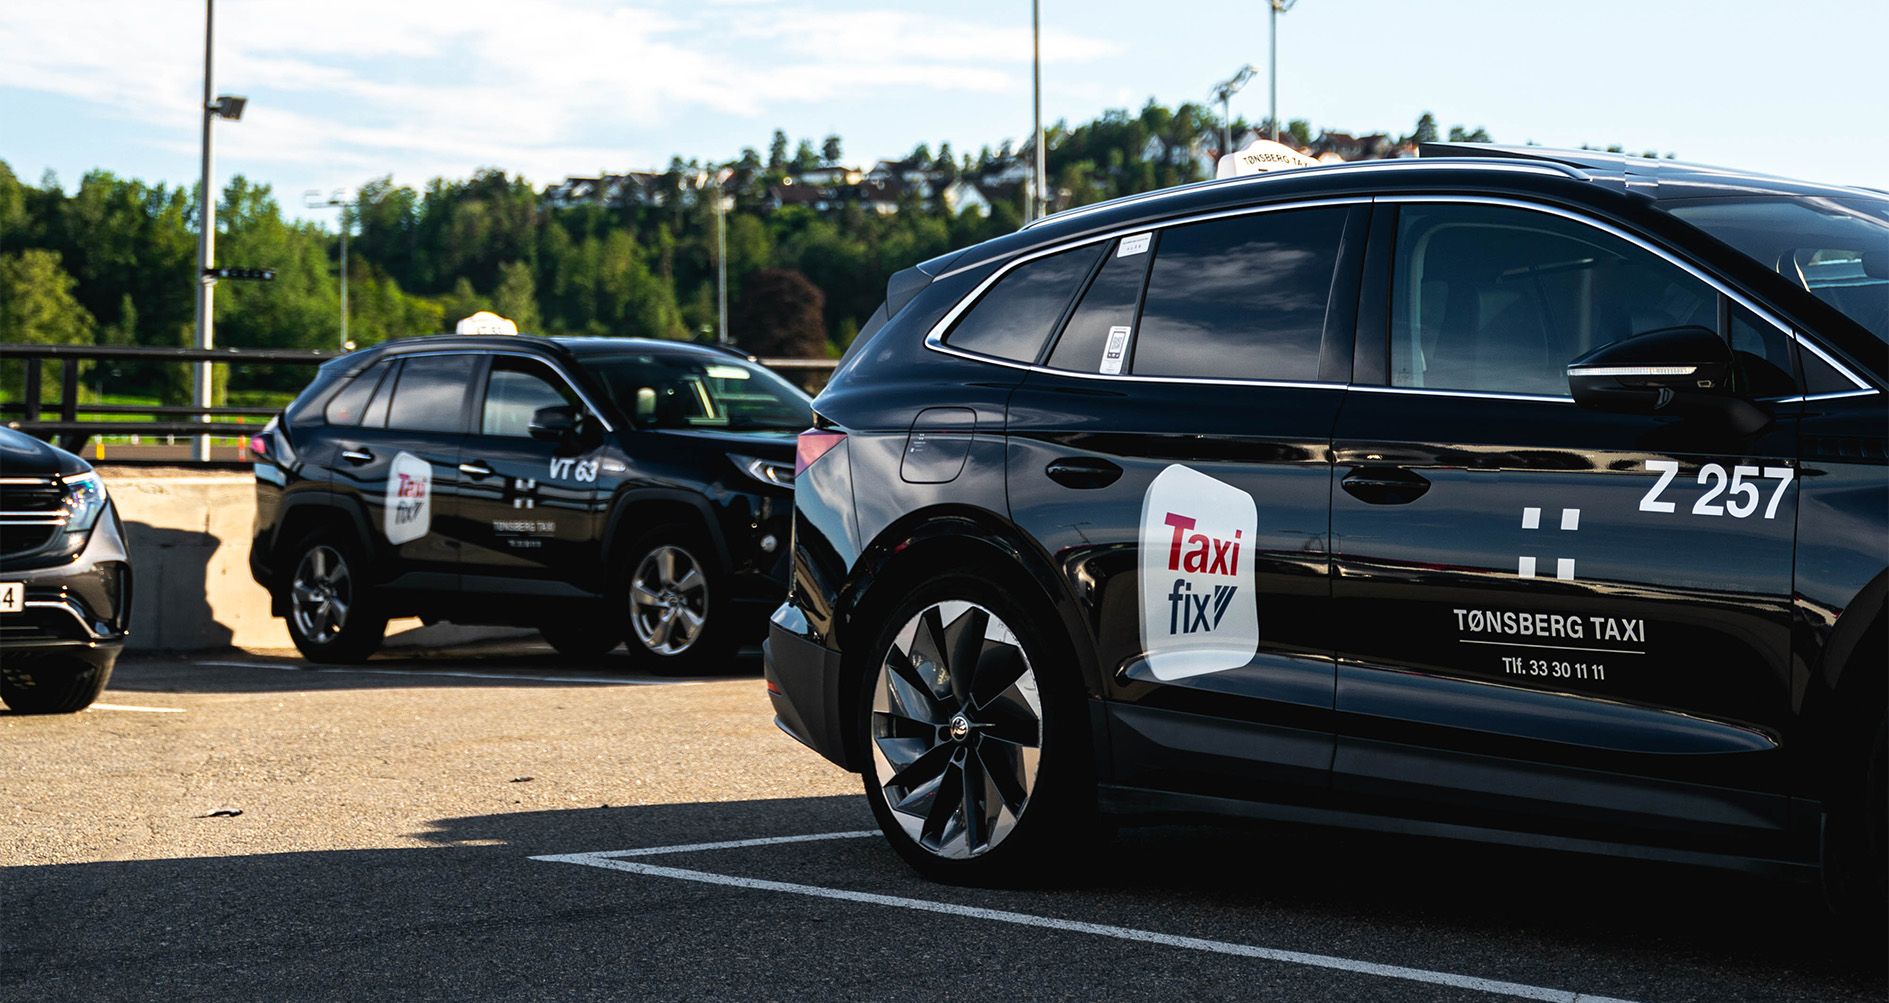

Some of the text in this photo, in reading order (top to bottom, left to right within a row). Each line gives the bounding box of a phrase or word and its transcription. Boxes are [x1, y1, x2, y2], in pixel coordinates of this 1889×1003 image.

[1243, 153, 1290, 165] TØNSBERG
[549, 457, 599, 482] VT 63
[1638, 459, 1794, 519] Z 257
[1164, 511, 1243, 577] Taxi
[1168, 578, 1212, 636] fix
[1453, 608, 1646, 642] TØNSBERG TAXI
[1501, 656, 1605, 681] Tlf. 33 30 11 11
